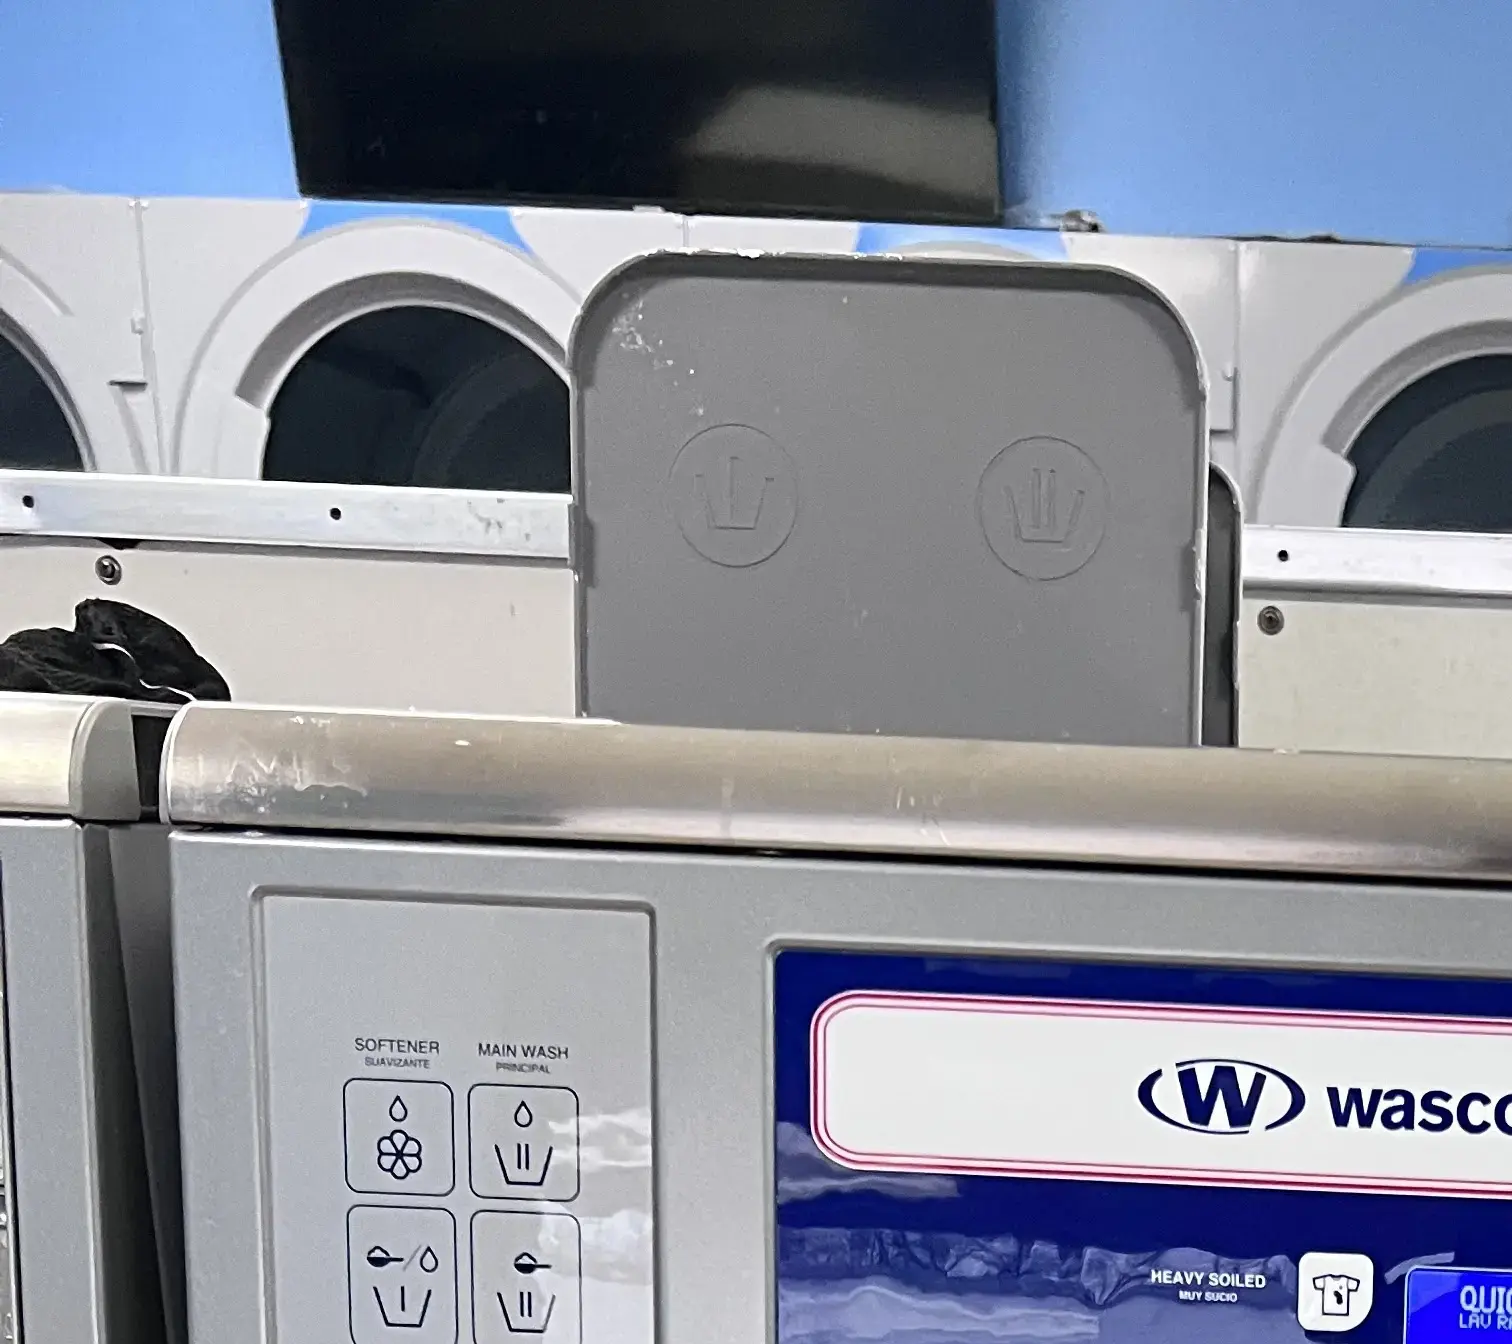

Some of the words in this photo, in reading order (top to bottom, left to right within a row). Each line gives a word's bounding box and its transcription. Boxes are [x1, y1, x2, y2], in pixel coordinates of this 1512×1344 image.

[355, 1037, 440, 1055] SOFTENER
[478, 1042, 517, 1058] MAIN
[521, 1045, 569, 1060] WASH
[364, 1056, 430, 1069] SUAVIZANTE
[495, 1062, 551, 1074] PRINCIPAL
[1150, 1269, 1204, 1286] HEAVY
[1208, 1272, 1266, 1289] SOILED
[1179, 1290, 1203, 1301] MUY
[1205, 1291, 1238, 1303] SUCIO
[1459, 1313, 1491, 1329] LAV
